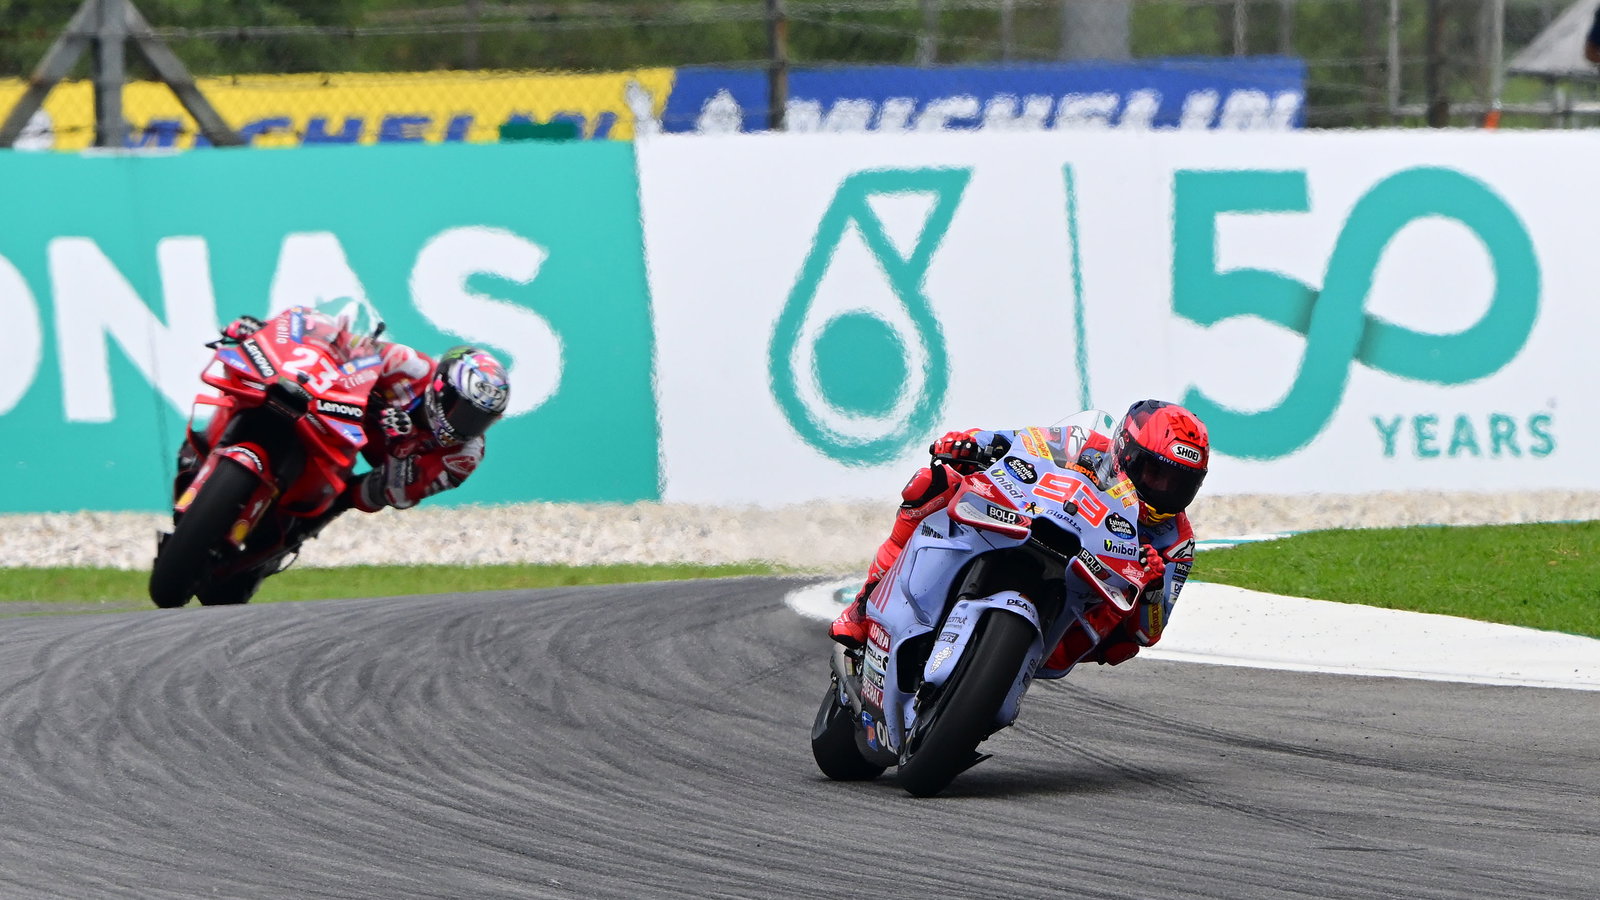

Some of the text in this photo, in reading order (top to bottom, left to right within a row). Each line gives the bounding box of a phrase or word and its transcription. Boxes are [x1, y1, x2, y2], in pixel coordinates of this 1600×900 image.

[122, 115, 617, 148] MCHELN
[0, 225, 562, 423] NAS
[1171, 165, 1543, 462] 50
[243, 338, 274, 377] Lenovo
[281, 347, 340, 394] 23
[317, 399, 363, 417] Lenovo
[1369, 412, 1557, 458] YEARS
[1176, 446, 1200, 462] SHOEI
[1008, 460, 1028, 481] Galicia
[1012, 458, 1035, 479] Estrella
[990, 468, 1024, 499] Unibat
[1032, 472, 1110, 528] 93
[989, 507, 1016, 522] BOLD
[1108, 517, 1131, 529] Estrella
[1081, 550, 1102, 573] BOLD
[1104, 539, 1137, 557] Unibat
